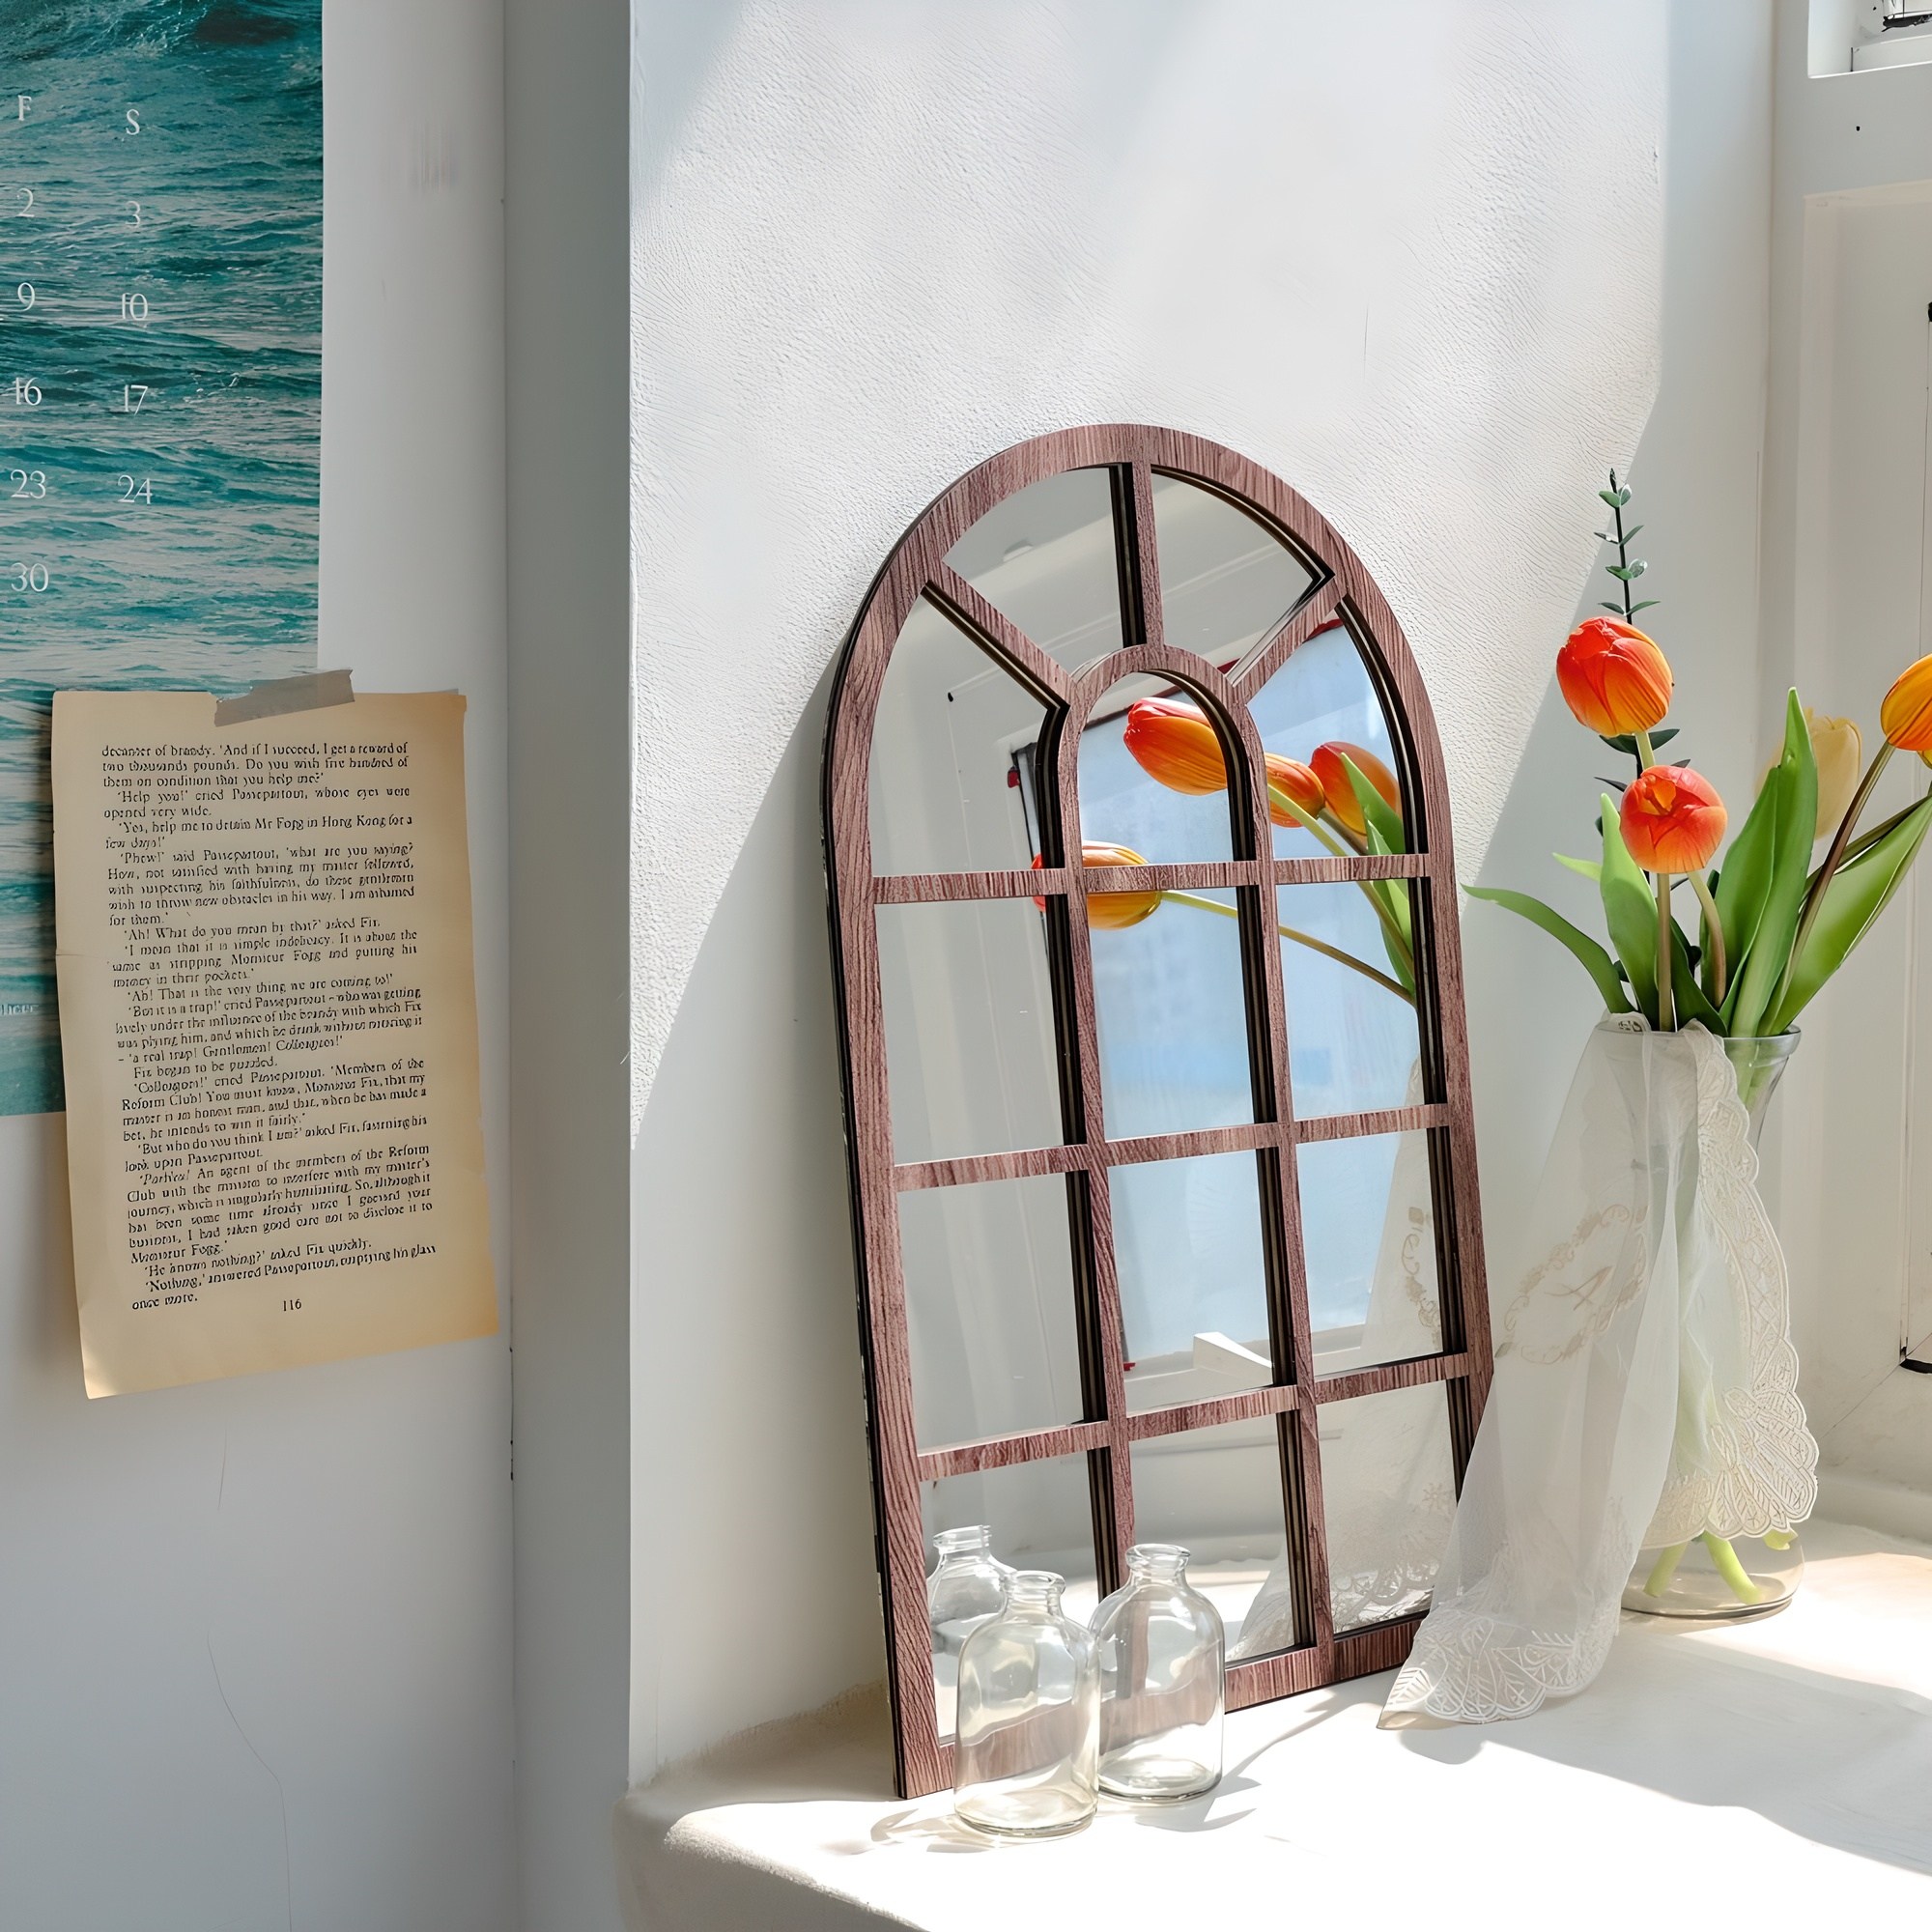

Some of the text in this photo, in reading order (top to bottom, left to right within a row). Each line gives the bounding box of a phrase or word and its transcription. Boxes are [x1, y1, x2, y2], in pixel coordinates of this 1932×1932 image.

[17, 95, 140, 135] F S
[15, 187, 141, 228] 2 3
[17, 282, 148, 321] 9 10
[15, 377, 149, 415] 16 17
[10, 469, 154, 505] 23 24
[11, 562, 49, 592] 30
[245, 757, 263, 769] Do
[307, 817, 319, 827] in
[191, 925, 207, 937] do
[191, 1138, 207, 1150] do
[284, 1298, 301, 1312] 116
